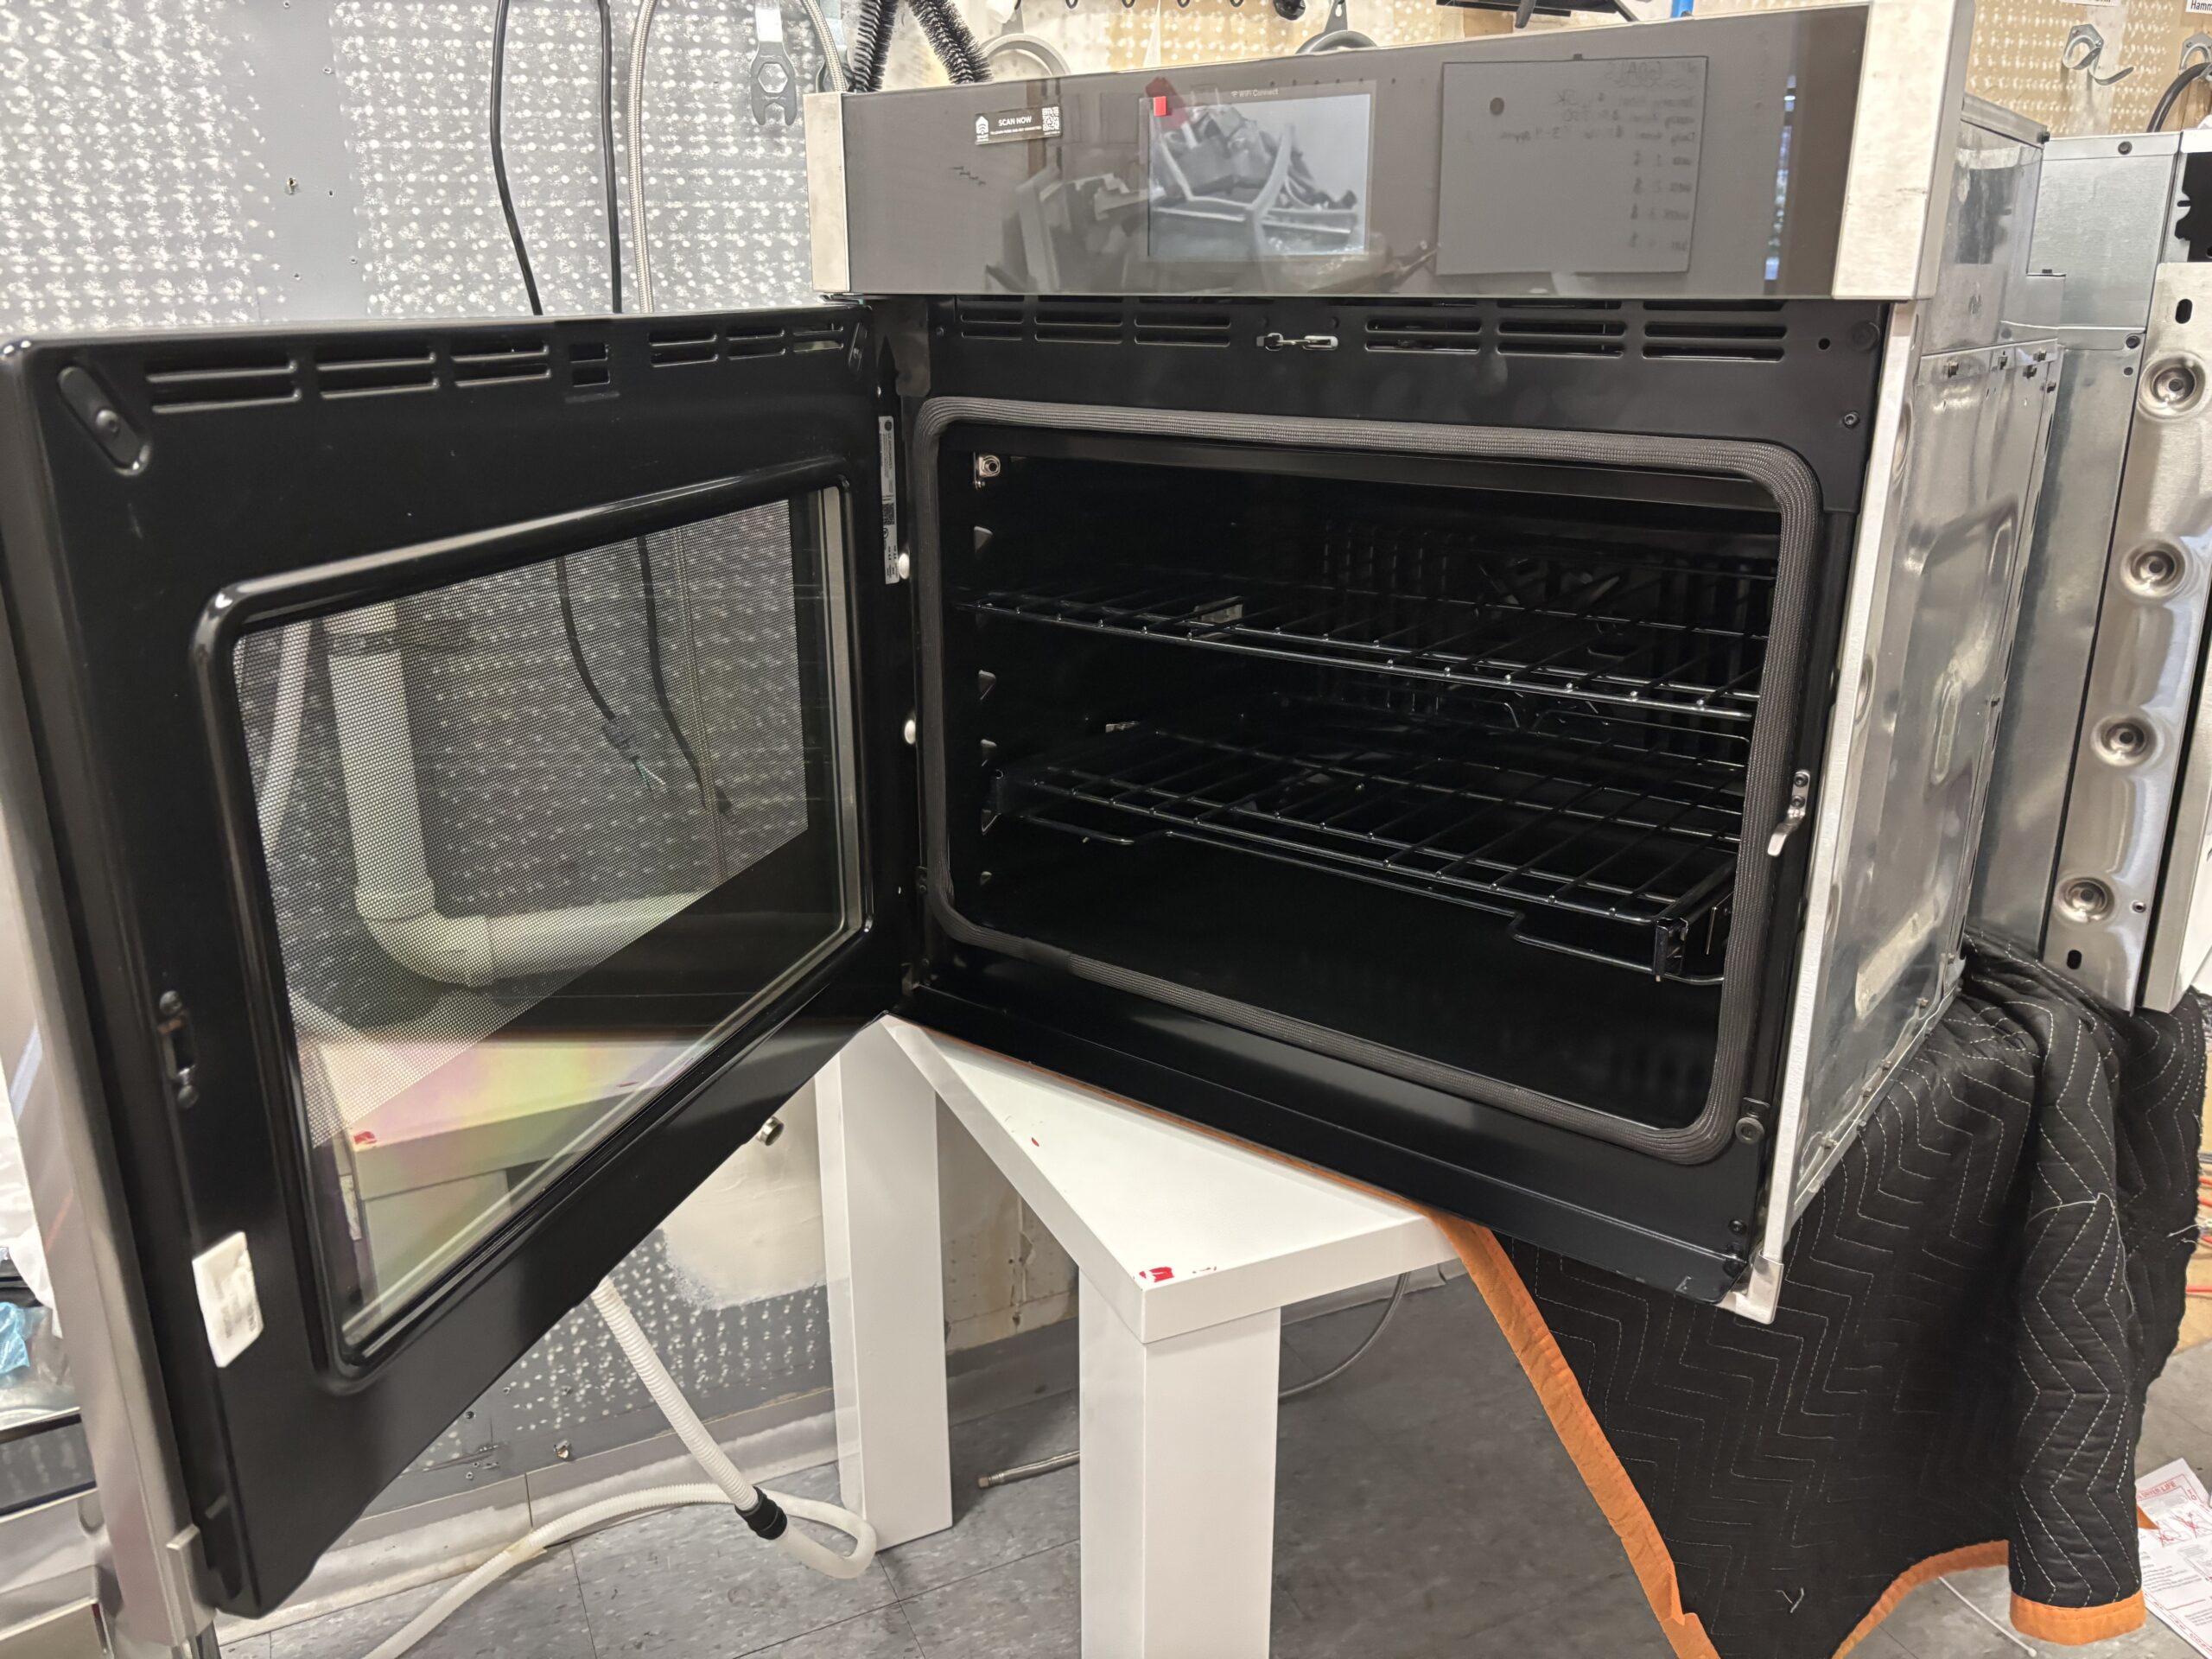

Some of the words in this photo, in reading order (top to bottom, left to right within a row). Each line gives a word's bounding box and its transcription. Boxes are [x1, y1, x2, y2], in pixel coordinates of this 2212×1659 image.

[1253, 88, 1278, 97] Connect
[998, 118, 1015, 126] SCAN
[1016, 116, 1033, 124] NOW
